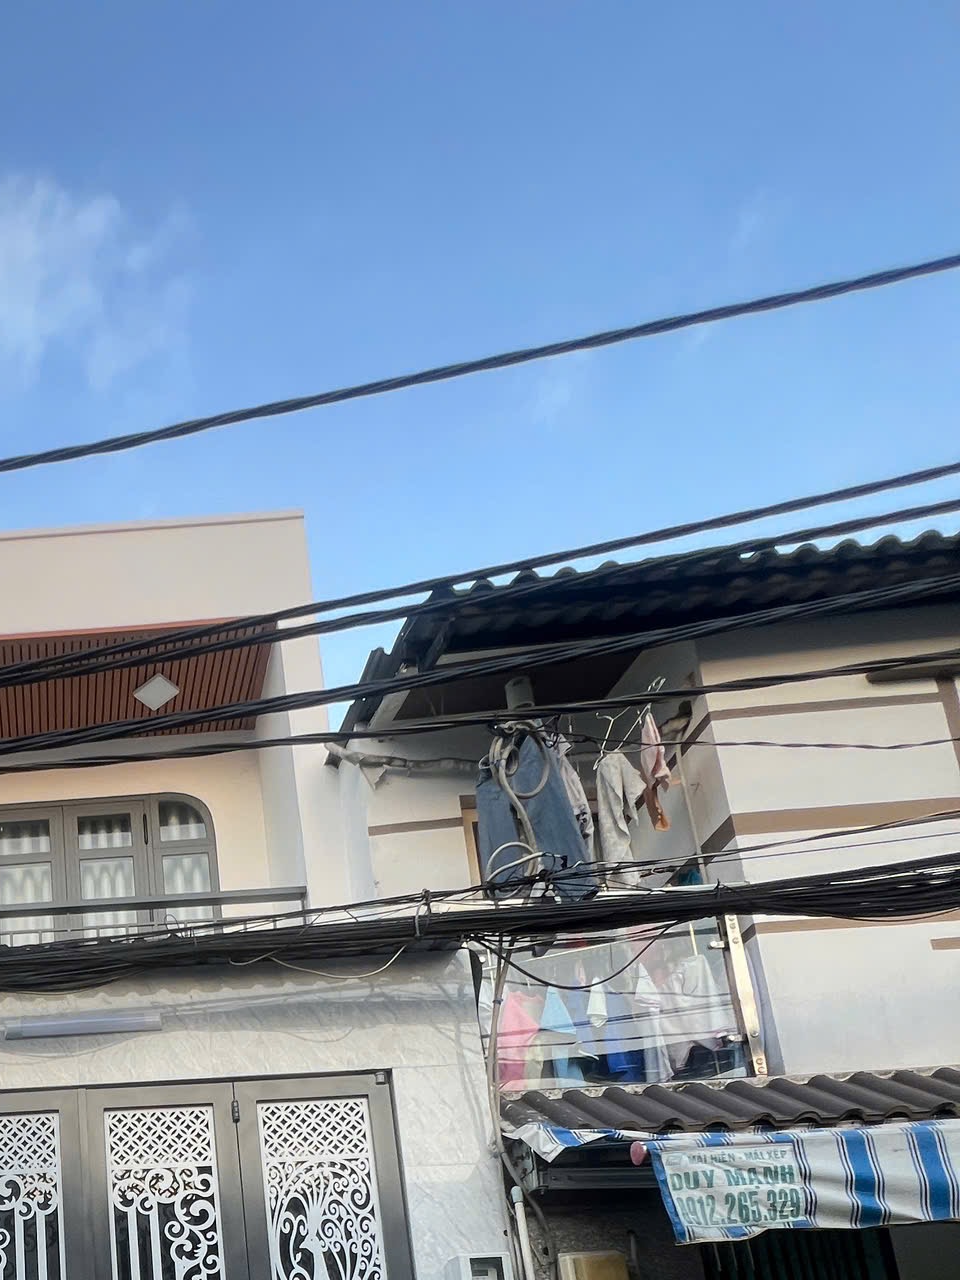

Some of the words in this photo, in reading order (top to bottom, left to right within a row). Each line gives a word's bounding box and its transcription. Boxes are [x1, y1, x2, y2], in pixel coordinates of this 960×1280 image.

[669, 1170, 715, 1191] DUY
[724, 1165, 795, 1189] MẠNH
[675, 1188, 800, 1226] 0912.265.329
